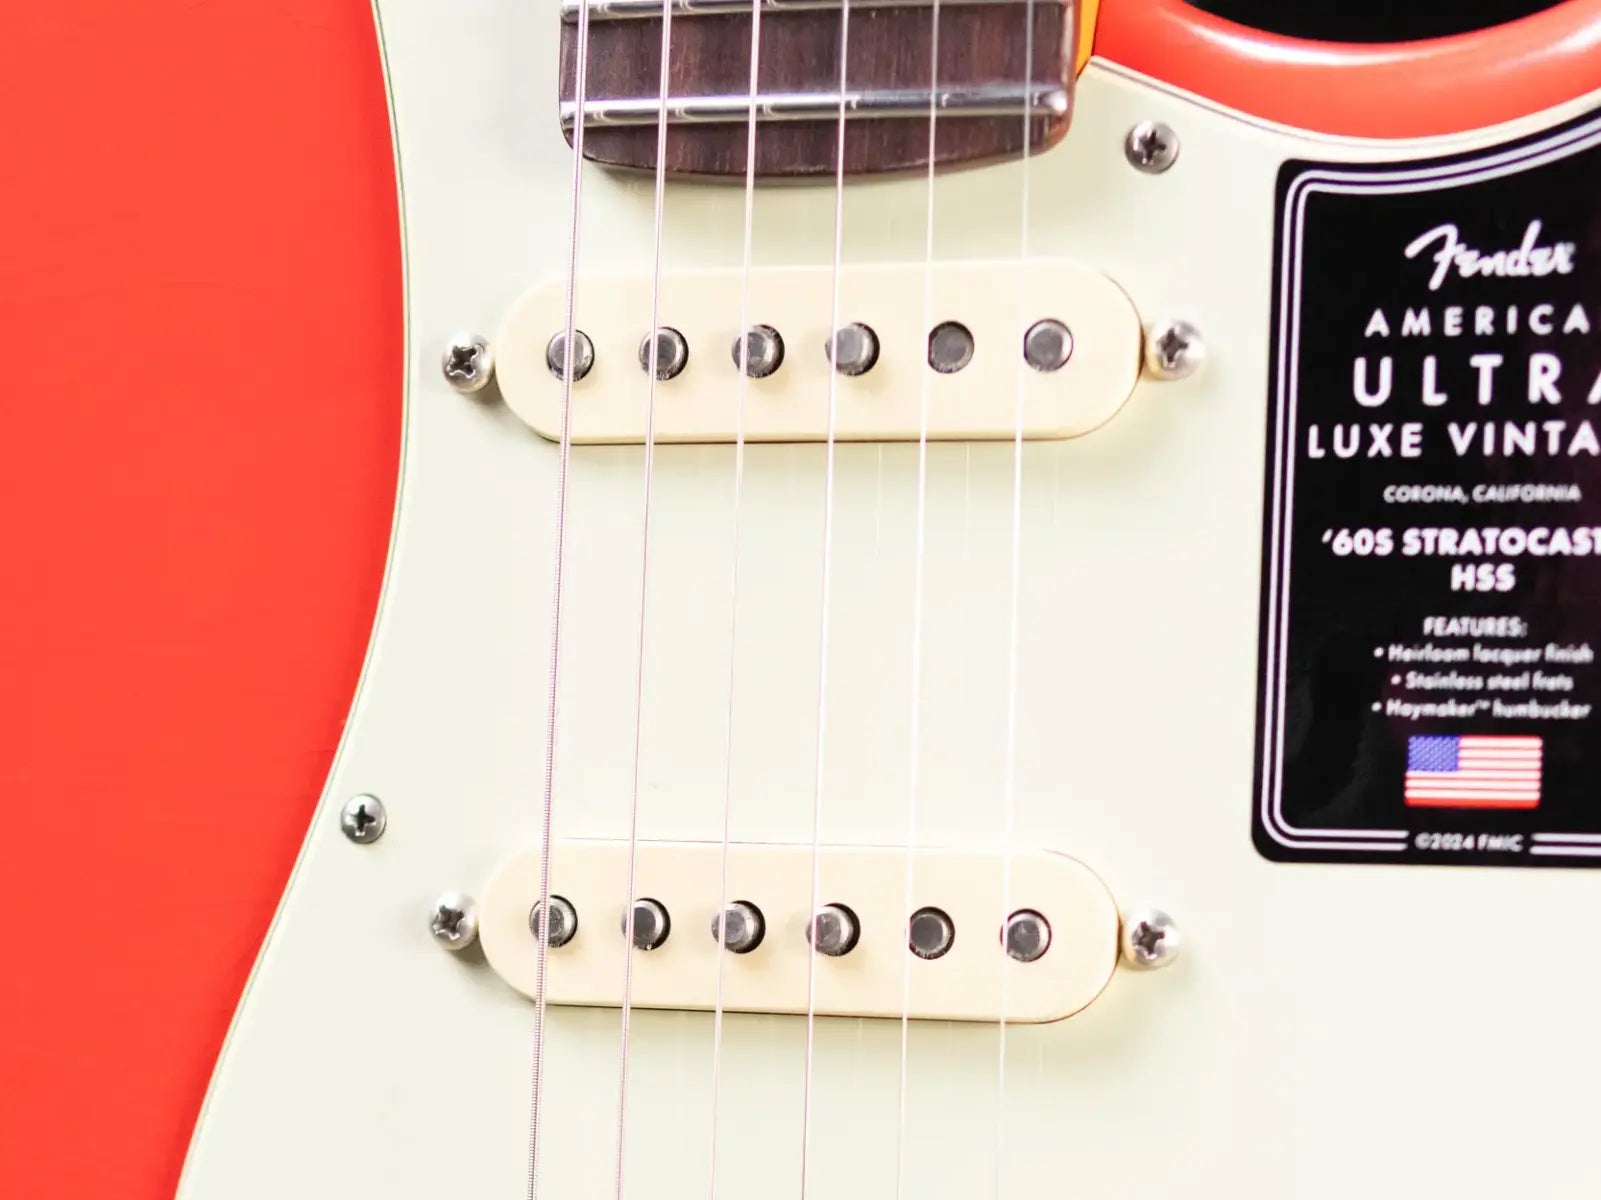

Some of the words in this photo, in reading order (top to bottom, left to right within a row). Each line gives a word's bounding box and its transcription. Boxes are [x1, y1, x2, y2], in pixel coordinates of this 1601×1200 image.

[1404, 219, 1576, 291] Fender
[1308, 422, 1424, 459] LUXE
[1447, 420, 1601, 457] VINTA
[1382, 484, 1468, 504] CORONA,
[1471, 484, 1582, 504] CALIFORNIA
[1450, 563, 1516, 592] HSS
[1422, 615, 1528, 638] FEATURES:
[1387, 643, 1470, 663] Heirloom
[1472, 643, 1542, 667] lacquer
[1544, 643, 1595, 664] finish
[1404, 671, 1485, 691] Stainless
[1486, 671, 1530, 691] steel
[1532, 672, 1574, 692] frets
[1492, 699, 1592, 720] humbucker
[1477, 833, 1524, 853] FMIC
